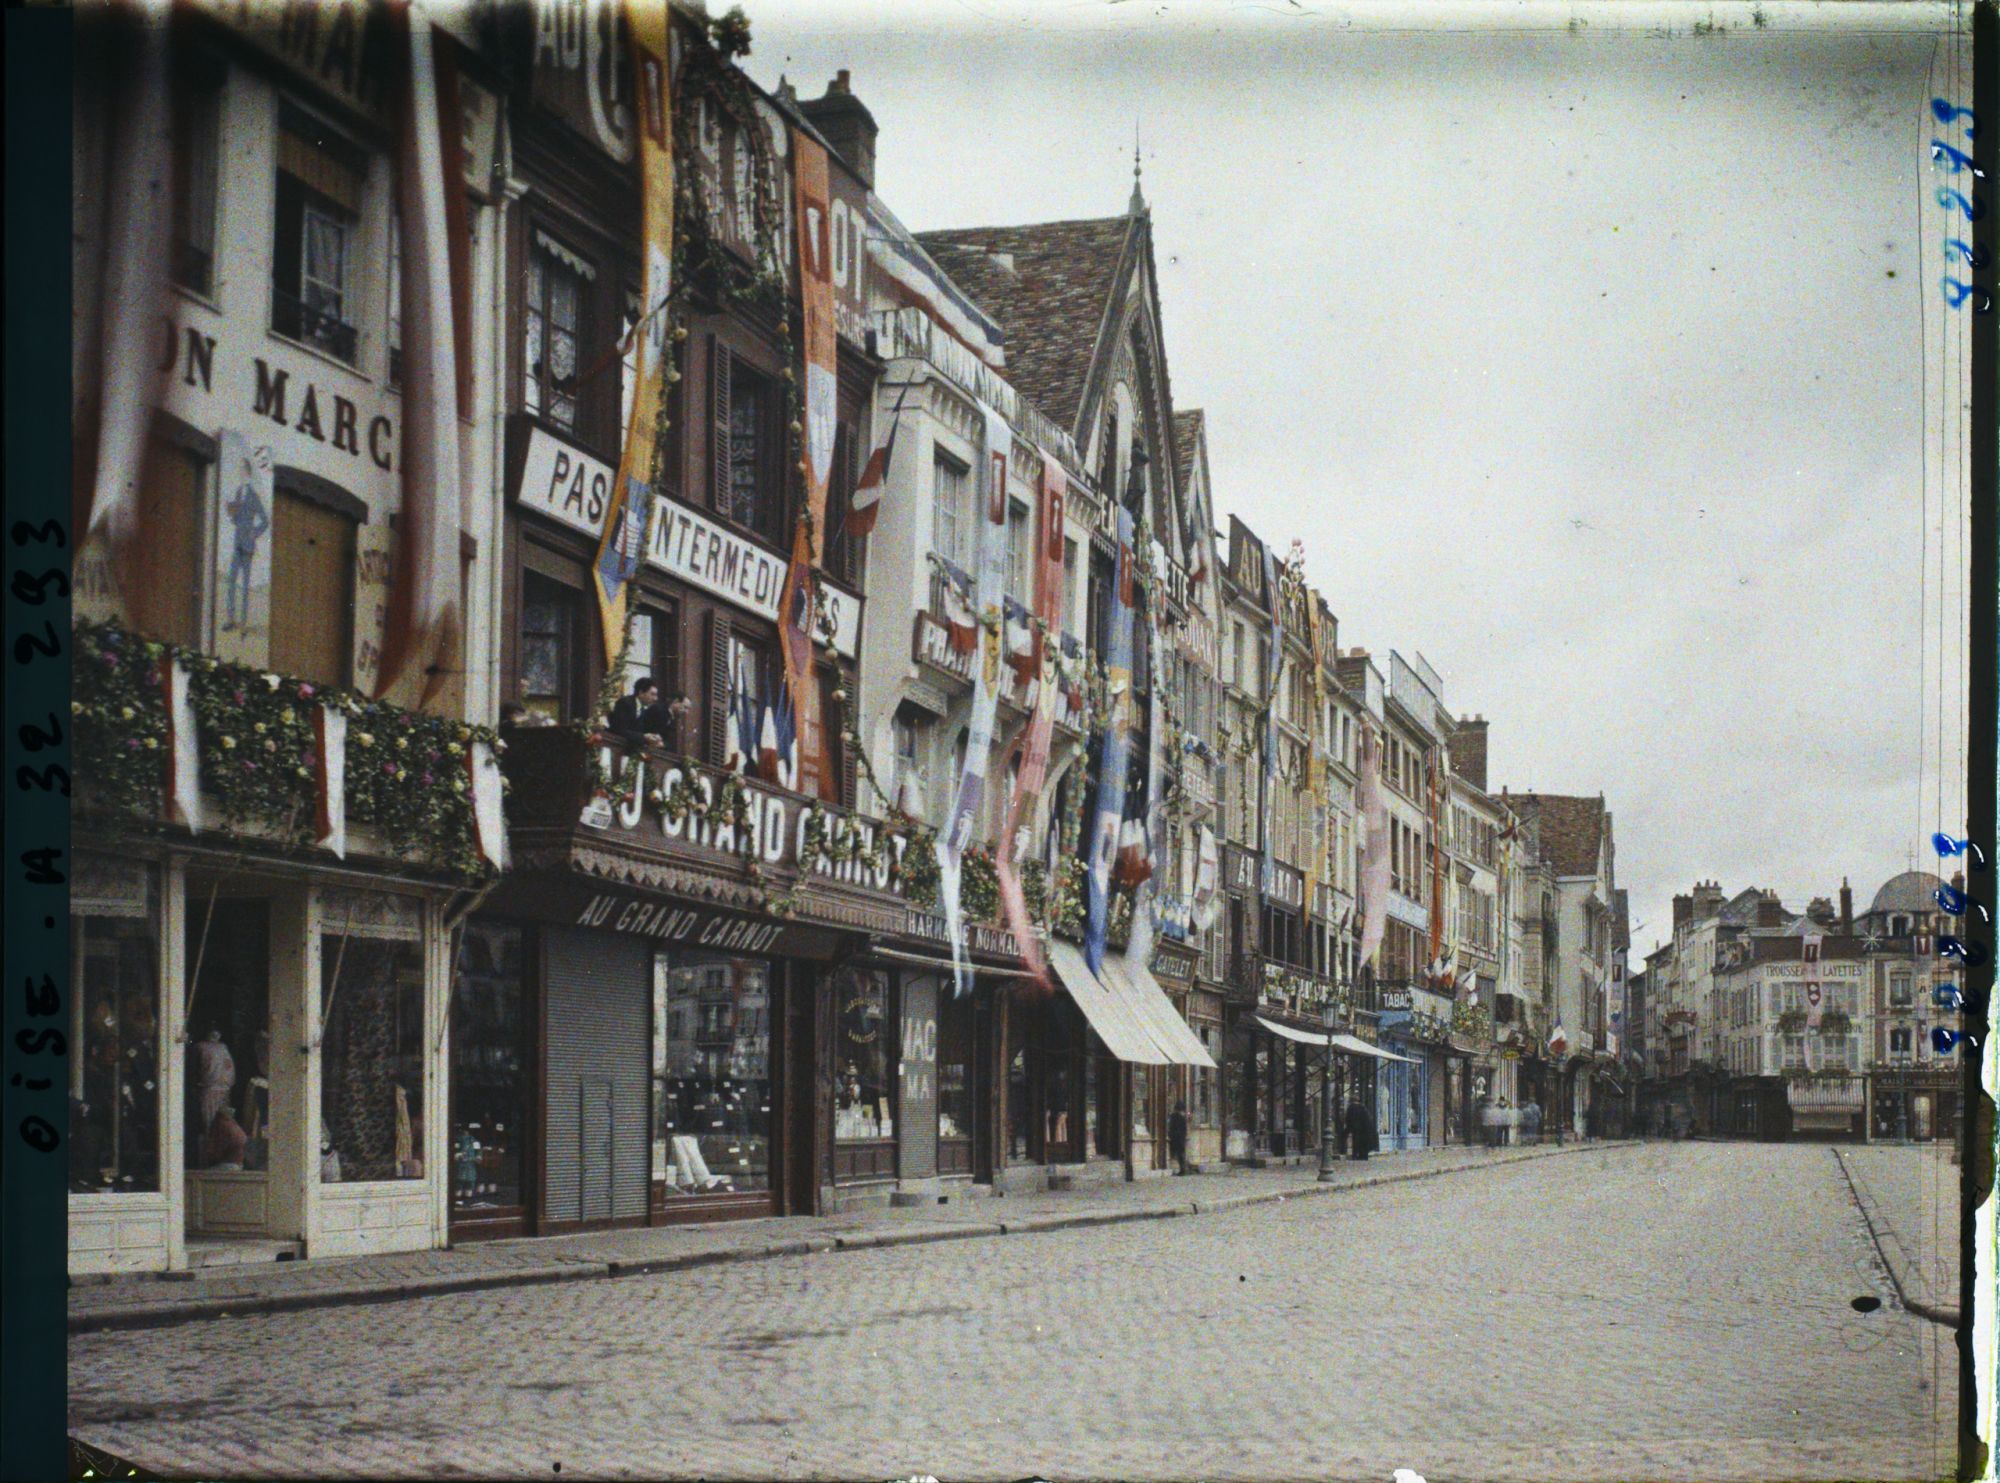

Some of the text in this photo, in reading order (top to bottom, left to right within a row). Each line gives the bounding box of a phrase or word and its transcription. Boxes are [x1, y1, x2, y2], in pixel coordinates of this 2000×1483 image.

[548, 449, 608, 525] PAS
[10, 518, 70, 666] 293
[14, 712, 71, 797] 32
[25, 847, 63, 886] A
[577, 894, 784, 952] AU GRAND CARNOT
[907, 910, 970, 948] HARMAIE
